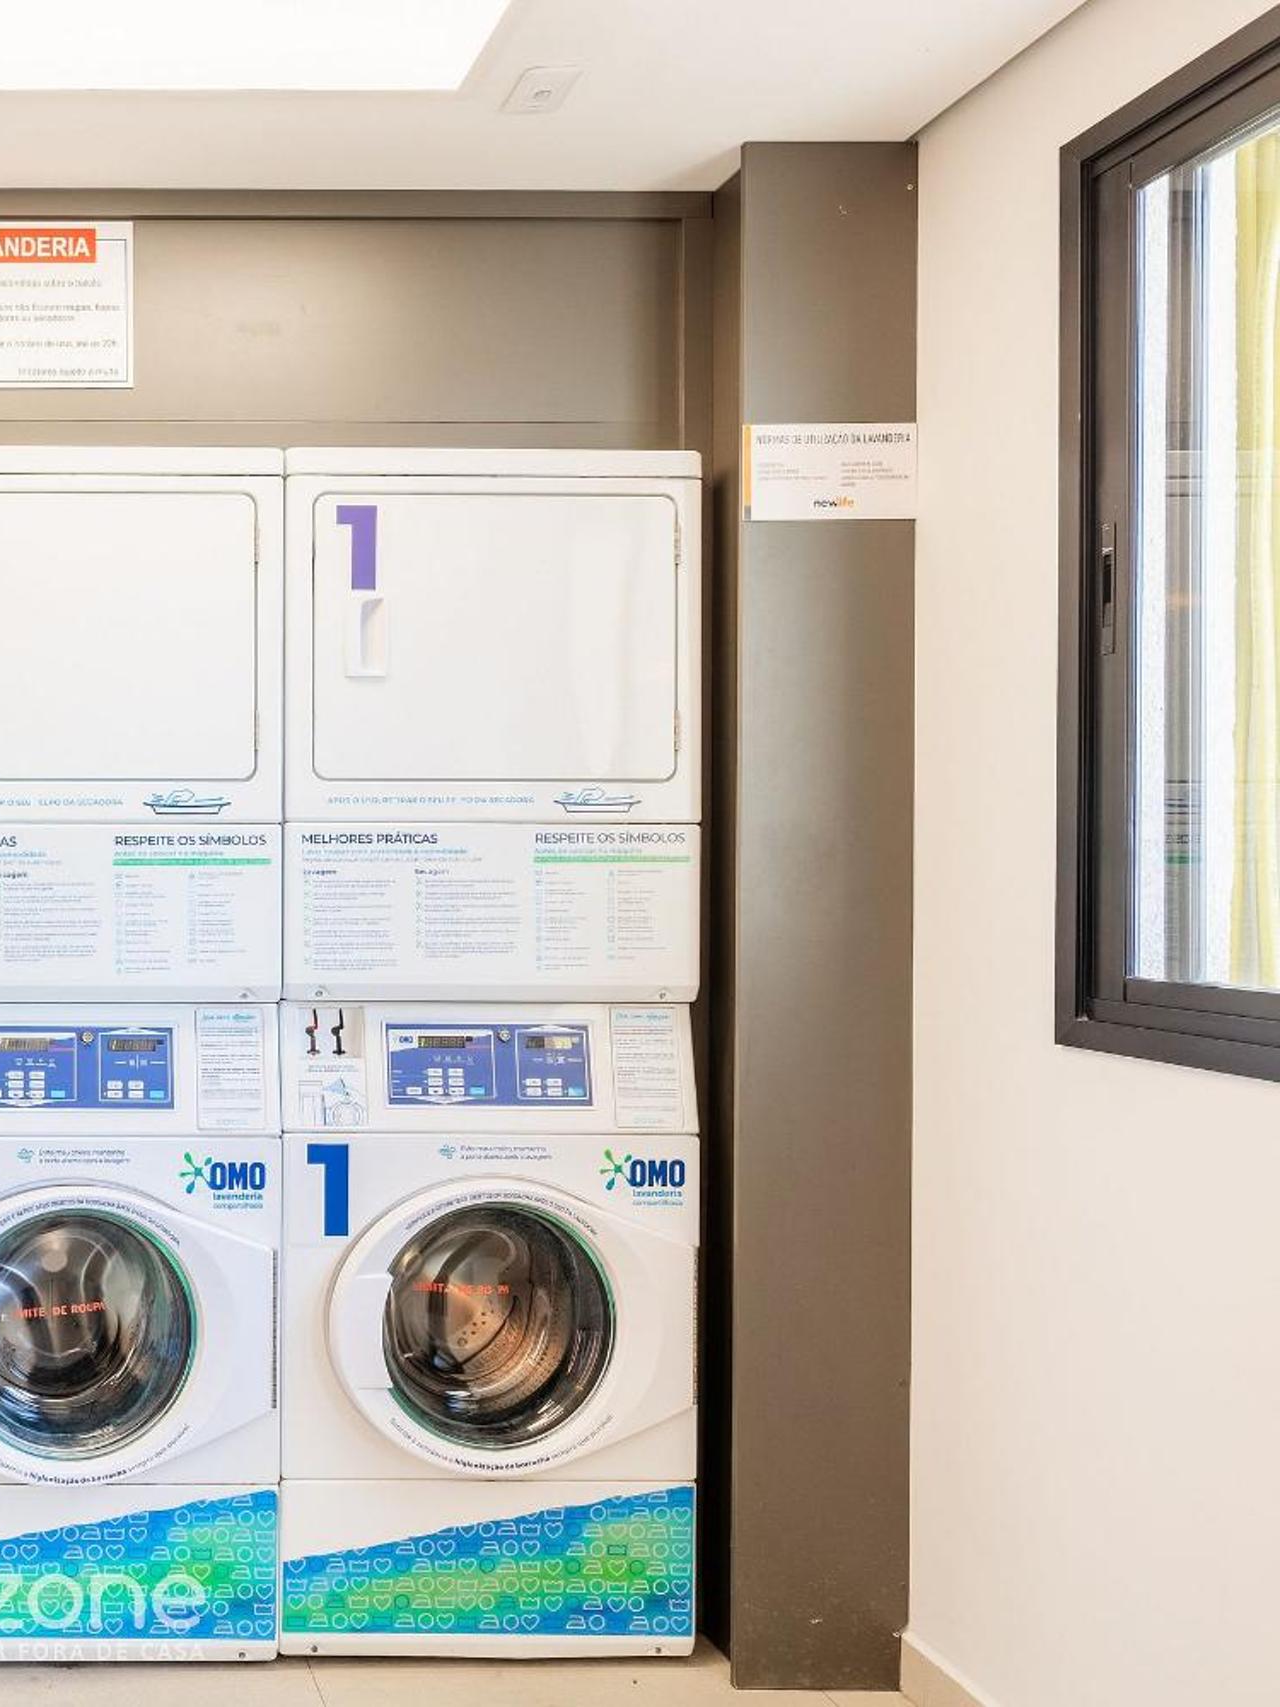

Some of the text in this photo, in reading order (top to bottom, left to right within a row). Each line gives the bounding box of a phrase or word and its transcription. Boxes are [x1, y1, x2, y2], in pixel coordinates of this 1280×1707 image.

[863, 433, 910, 444] LAVANDERIA
[336, 505, 377, 591] 1
[115, 833, 268, 846] RESPEITE OS SÍMBOLOS
[302, 832, 438, 844] MELHORES PRÁTICAS
[535, 831, 686, 844] RESPEITE OS SÍMBOLOS
[209, 1162, 266, 1190] OMO
[630, 1159, 686, 1187] OMO
[213, 1192, 264, 1200] lavanderia
[307, 1144, 349, 1236] 1
[632, 1190, 682, 1198] lavanderia
[52, 1306, 68, 1316] DE
